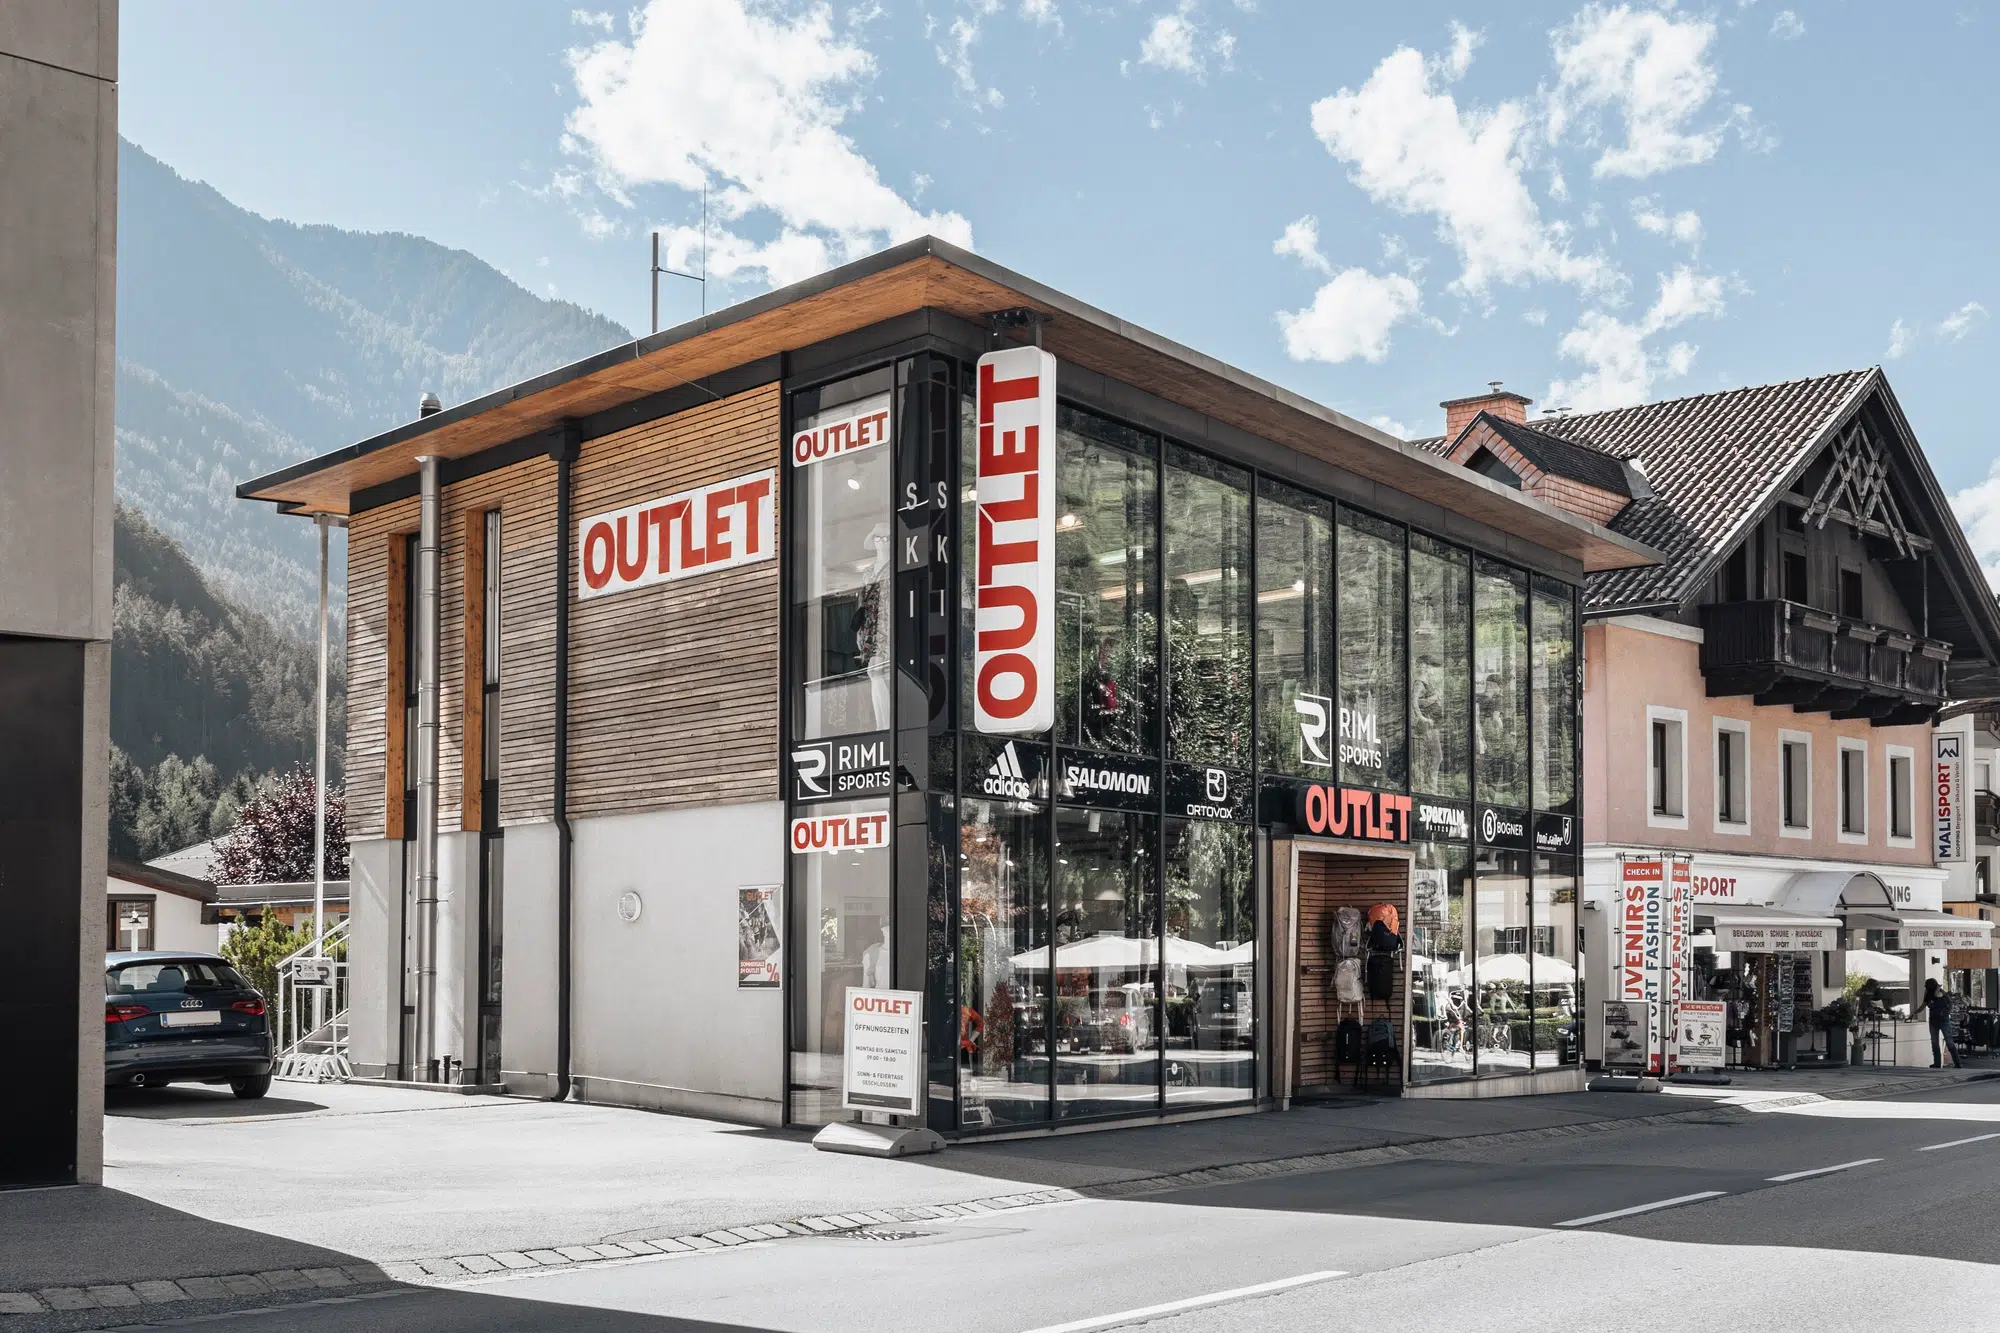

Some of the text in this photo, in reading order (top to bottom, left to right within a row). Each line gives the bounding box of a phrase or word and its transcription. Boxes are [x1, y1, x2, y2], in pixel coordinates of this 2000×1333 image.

[795, 411, 888, 462] OUTLET
[583, 478, 770, 589] OUTLET
[977, 364, 1039, 719] OUTLET
[1340, 708, 1381, 744] RIML
[839, 741, 890, 770] RIML
[1339, 744, 1382, 769] SPORTS
[838, 771, 890, 791] SPORTS
[983, 773, 1030, 799] adidas
[1067, 766, 1150, 795] SALOMON
[1187, 804, 1232, 819] ORTOVOX
[1305, 784, 1412, 841] OUTLET
[1938, 763, 1951, 857] MALISPORT
[794, 815, 887, 849] OUTLET
[1497, 822, 1523, 837] BOGNER
[1626, 868, 1660, 876] CHECK IN
[1693, 876, 1736, 897] SPORT
[1646, 887, 1659, 970] FASHION
[1681, 889, 1689, 971] FASHION
[853, 997, 912, 1014] OUTLET
[854, 1023, 909, 1035] ÖFFNUNGSZEITEN
[884, 1047, 908, 1055] SAMSTAG
